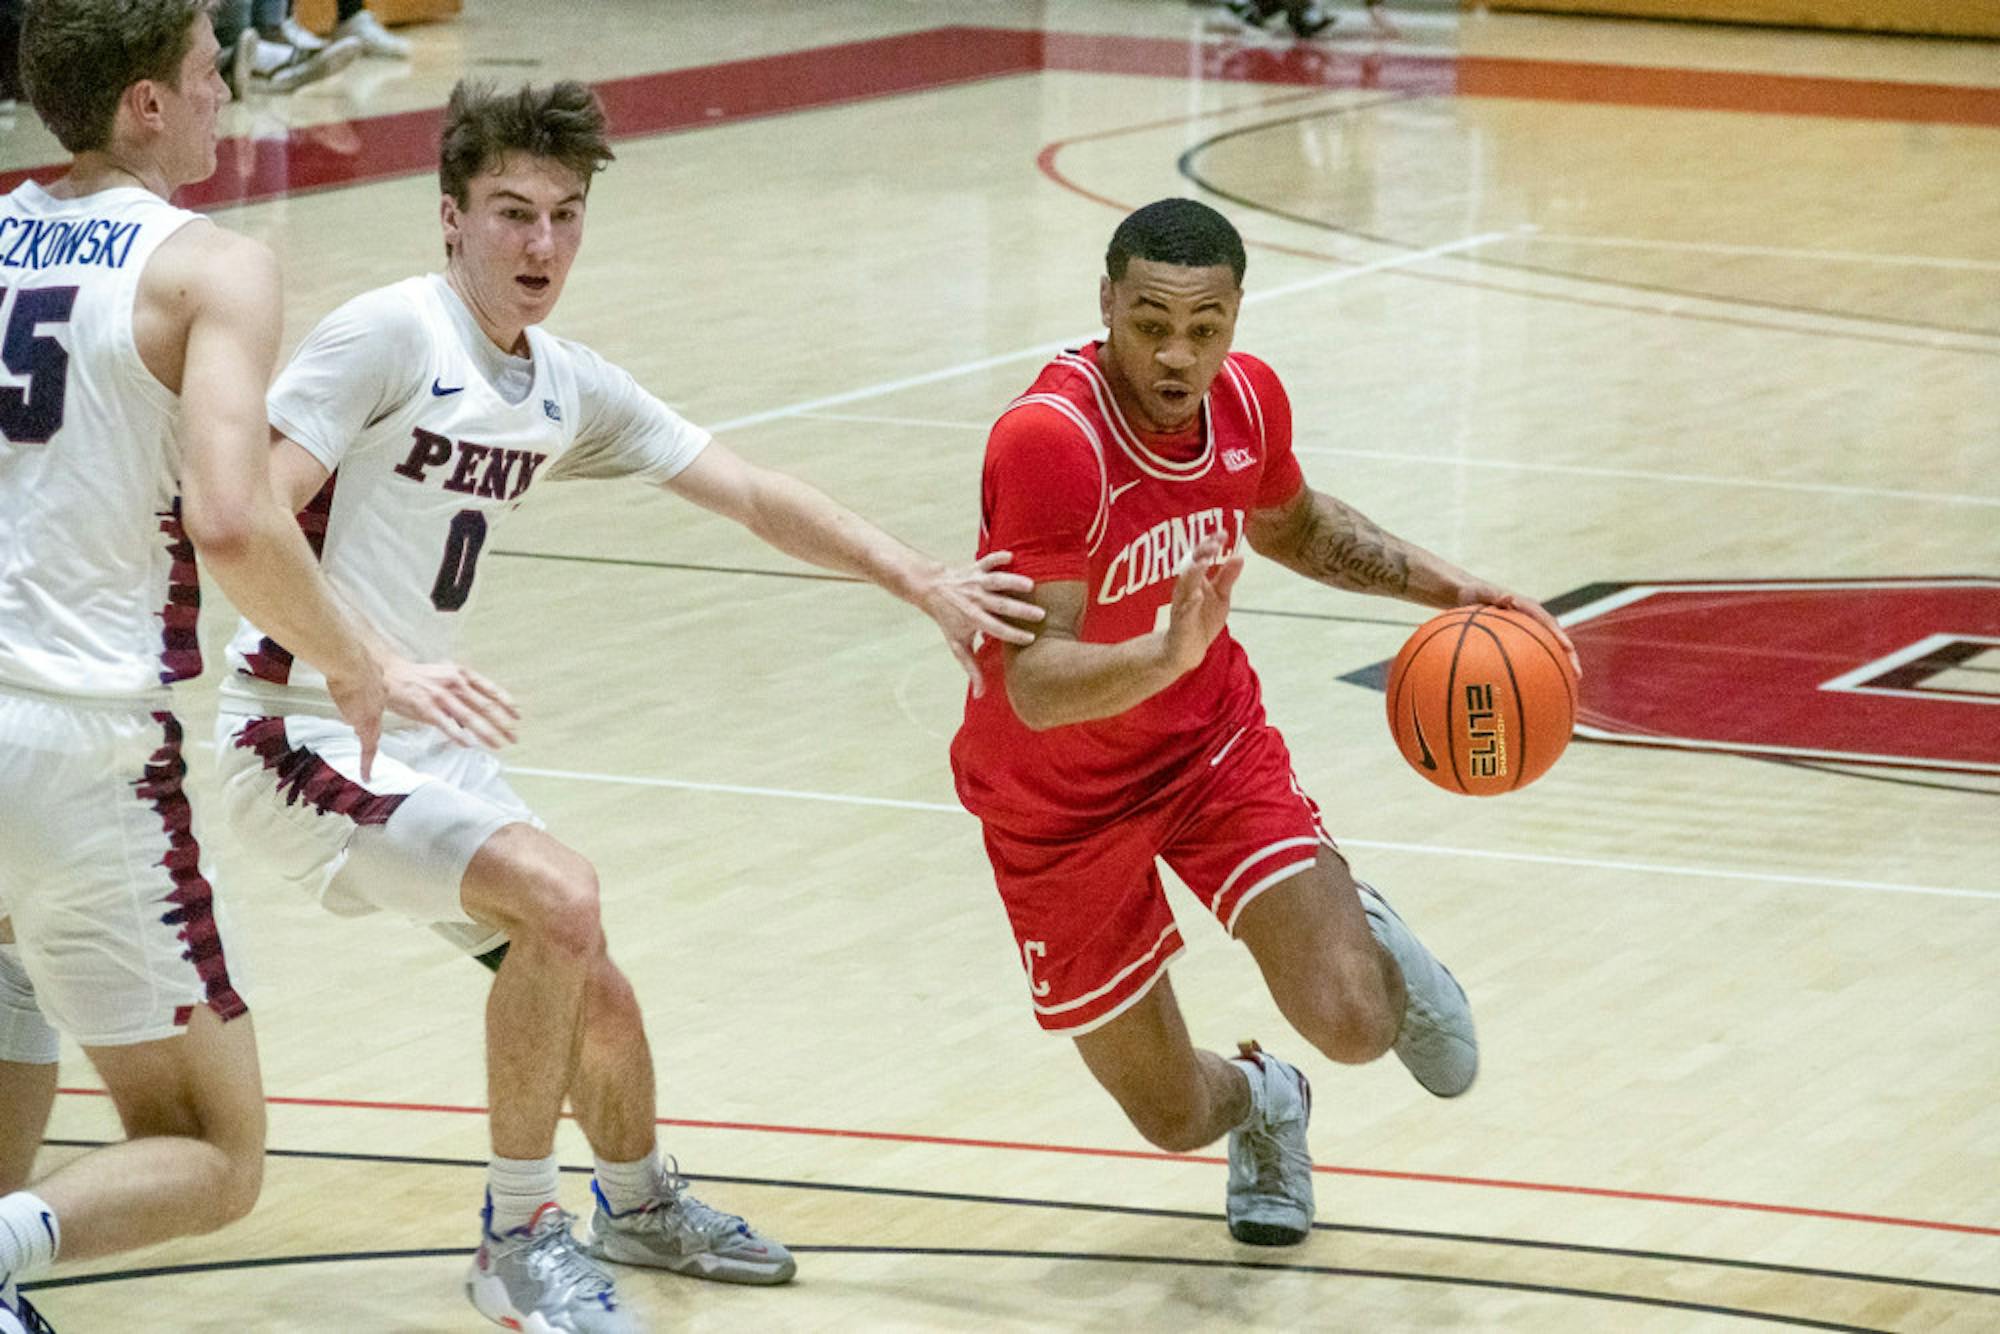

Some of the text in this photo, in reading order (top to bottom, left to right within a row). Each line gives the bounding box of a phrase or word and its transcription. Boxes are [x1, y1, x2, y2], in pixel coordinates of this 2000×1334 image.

[430, 509, 488, 613] 0
[1465, 683, 1496, 777] ELITE
[1023, 940, 1050, 997] C
